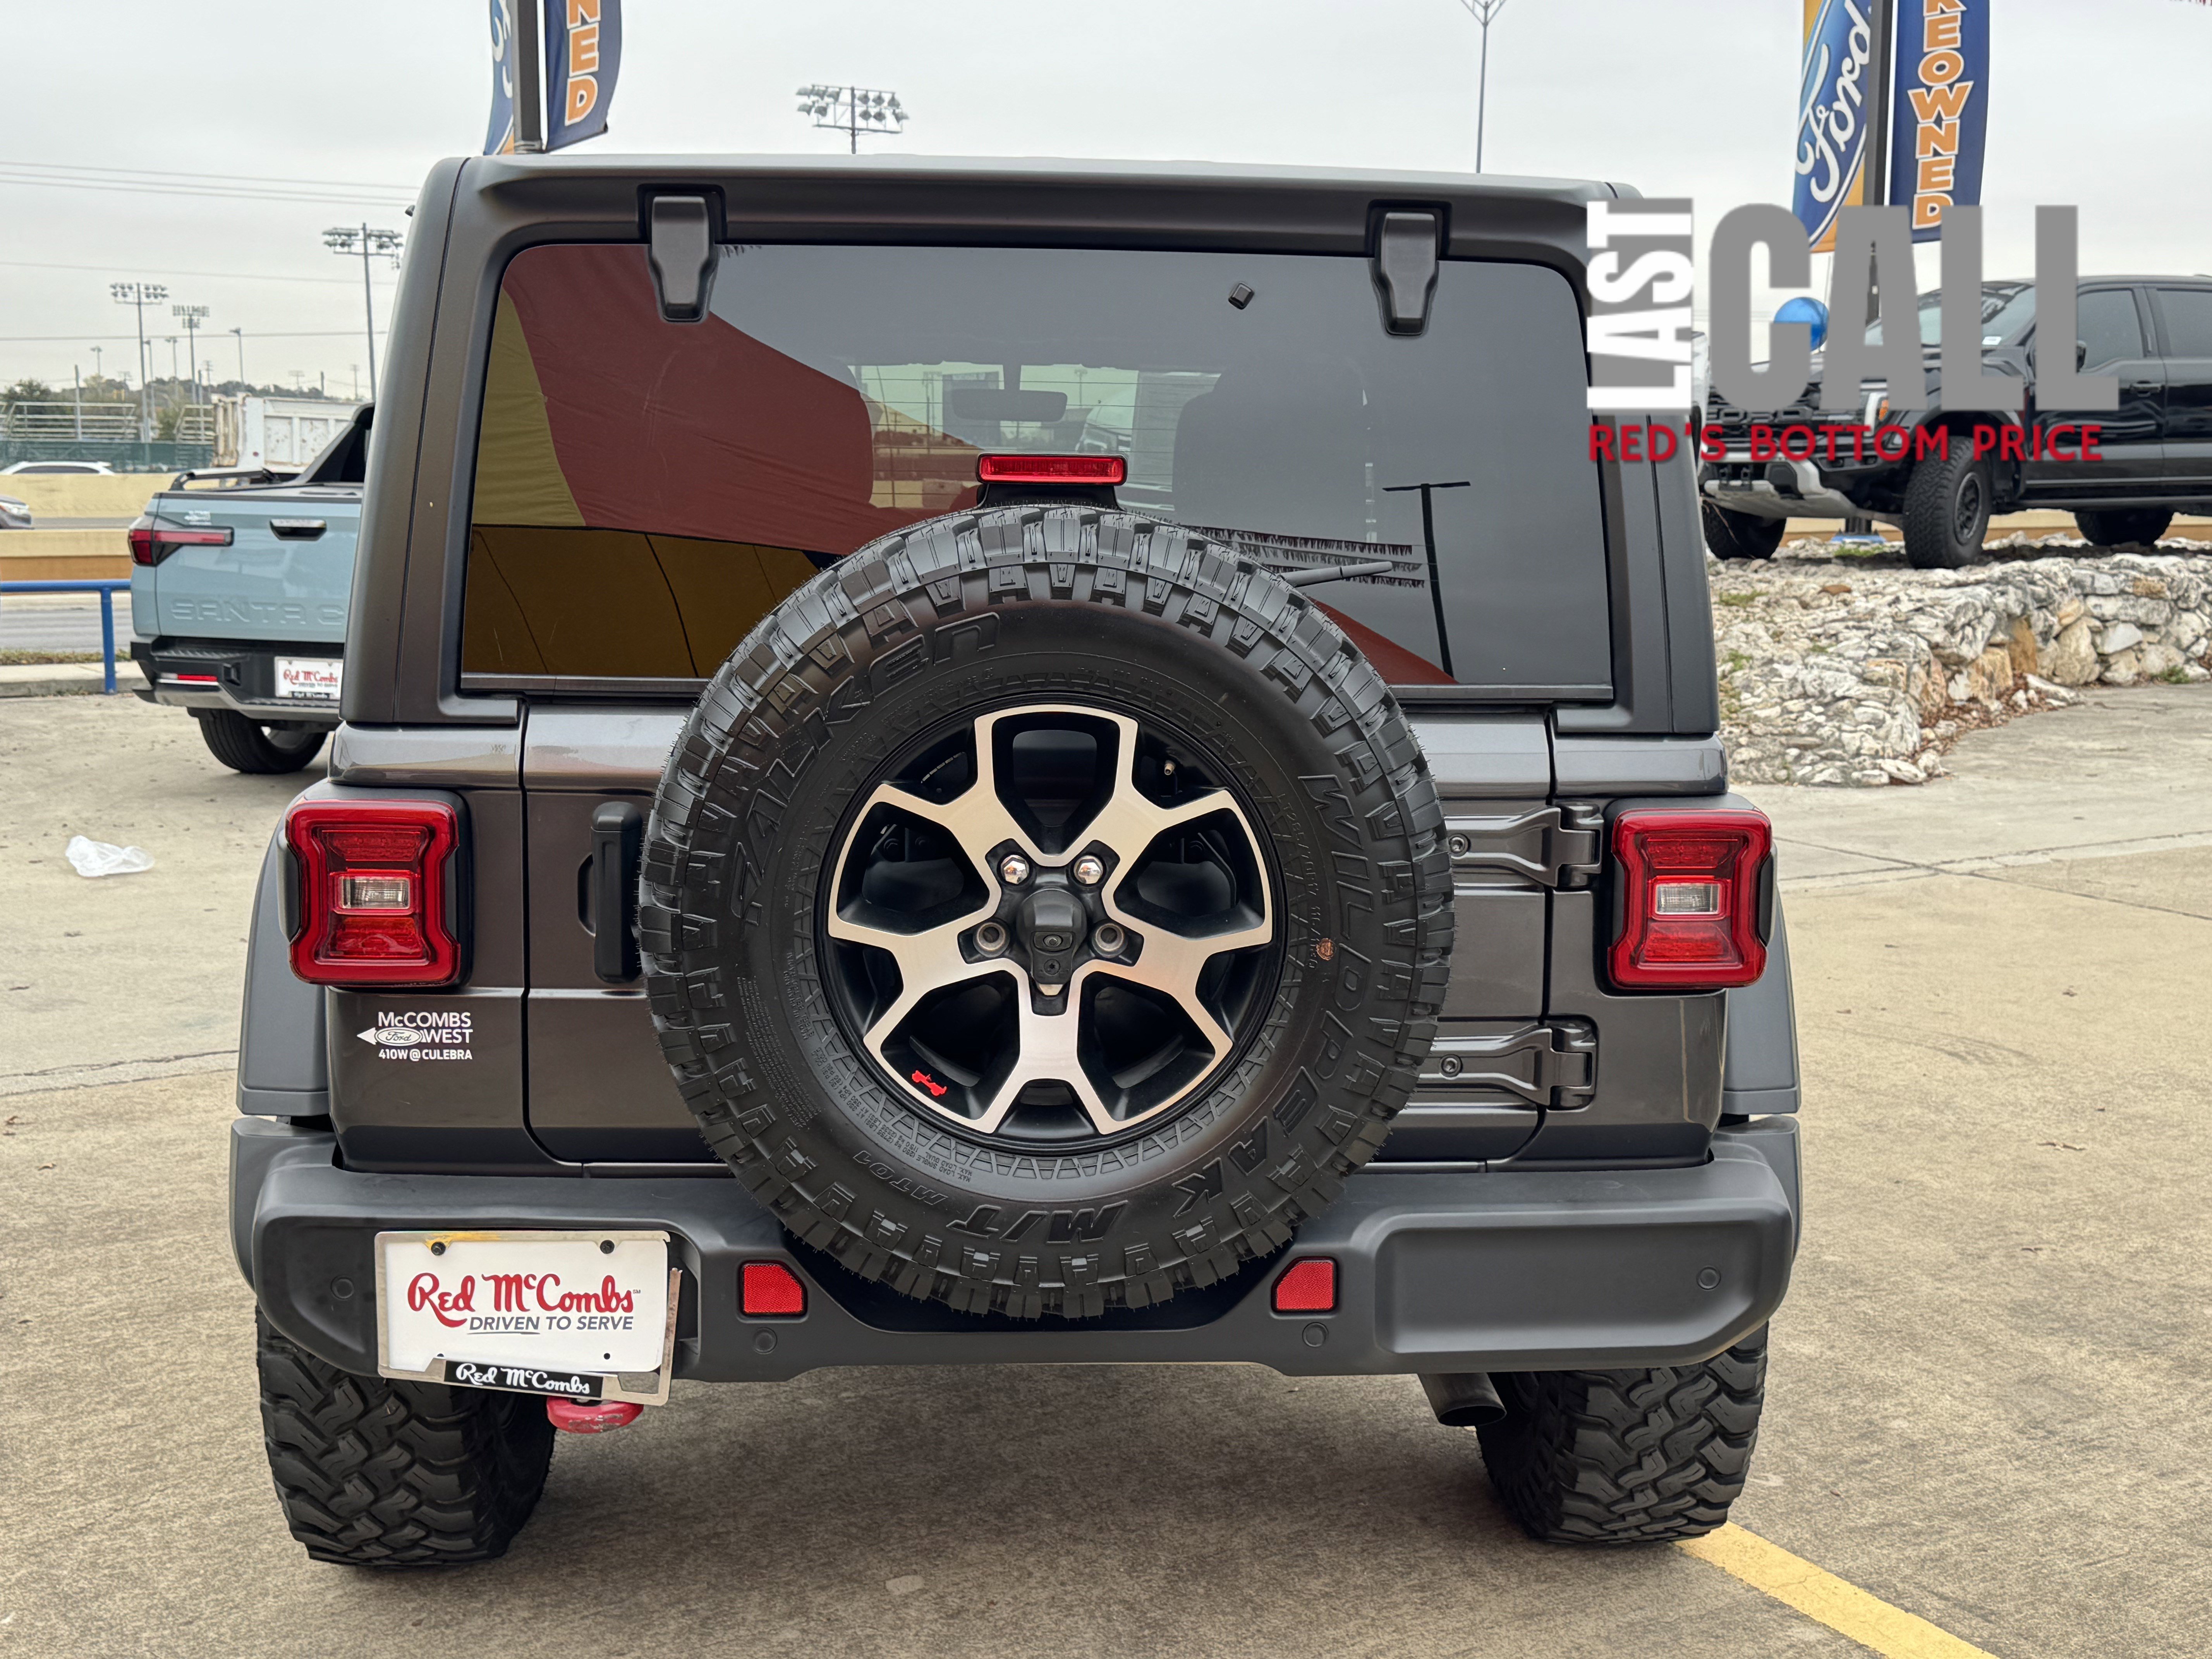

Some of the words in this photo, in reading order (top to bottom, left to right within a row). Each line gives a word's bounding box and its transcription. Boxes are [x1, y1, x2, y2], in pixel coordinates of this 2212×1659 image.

[1796, 0, 1871, 203] Ford
[171, 598, 306, 625] SANTA
[1172, 775, 1374, 1219] WILDPEAK
[378, 1012, 472, 1027] McCOMBS
[385, 1031, 412, 1042] Ford
[424, 1029, 473, 1043] WEST
[378, 1049, 408, 1060] 410W
[422, 1049, 472, 1060] CULEBRA
[946, 1200, 1128, 1244] M/T
[408, 1273, 476, 1327] Red
[481, 1273, 634, 1313] McCombs
[469, 1316, 540, 1330] DRIVEN
[546, 1316, 572, 1330] TO
[577, 1316, 634, 1330] SERVE
[455, 1363, 497, 1386] Red
[500, 1367, 590, 1395] McCombs
